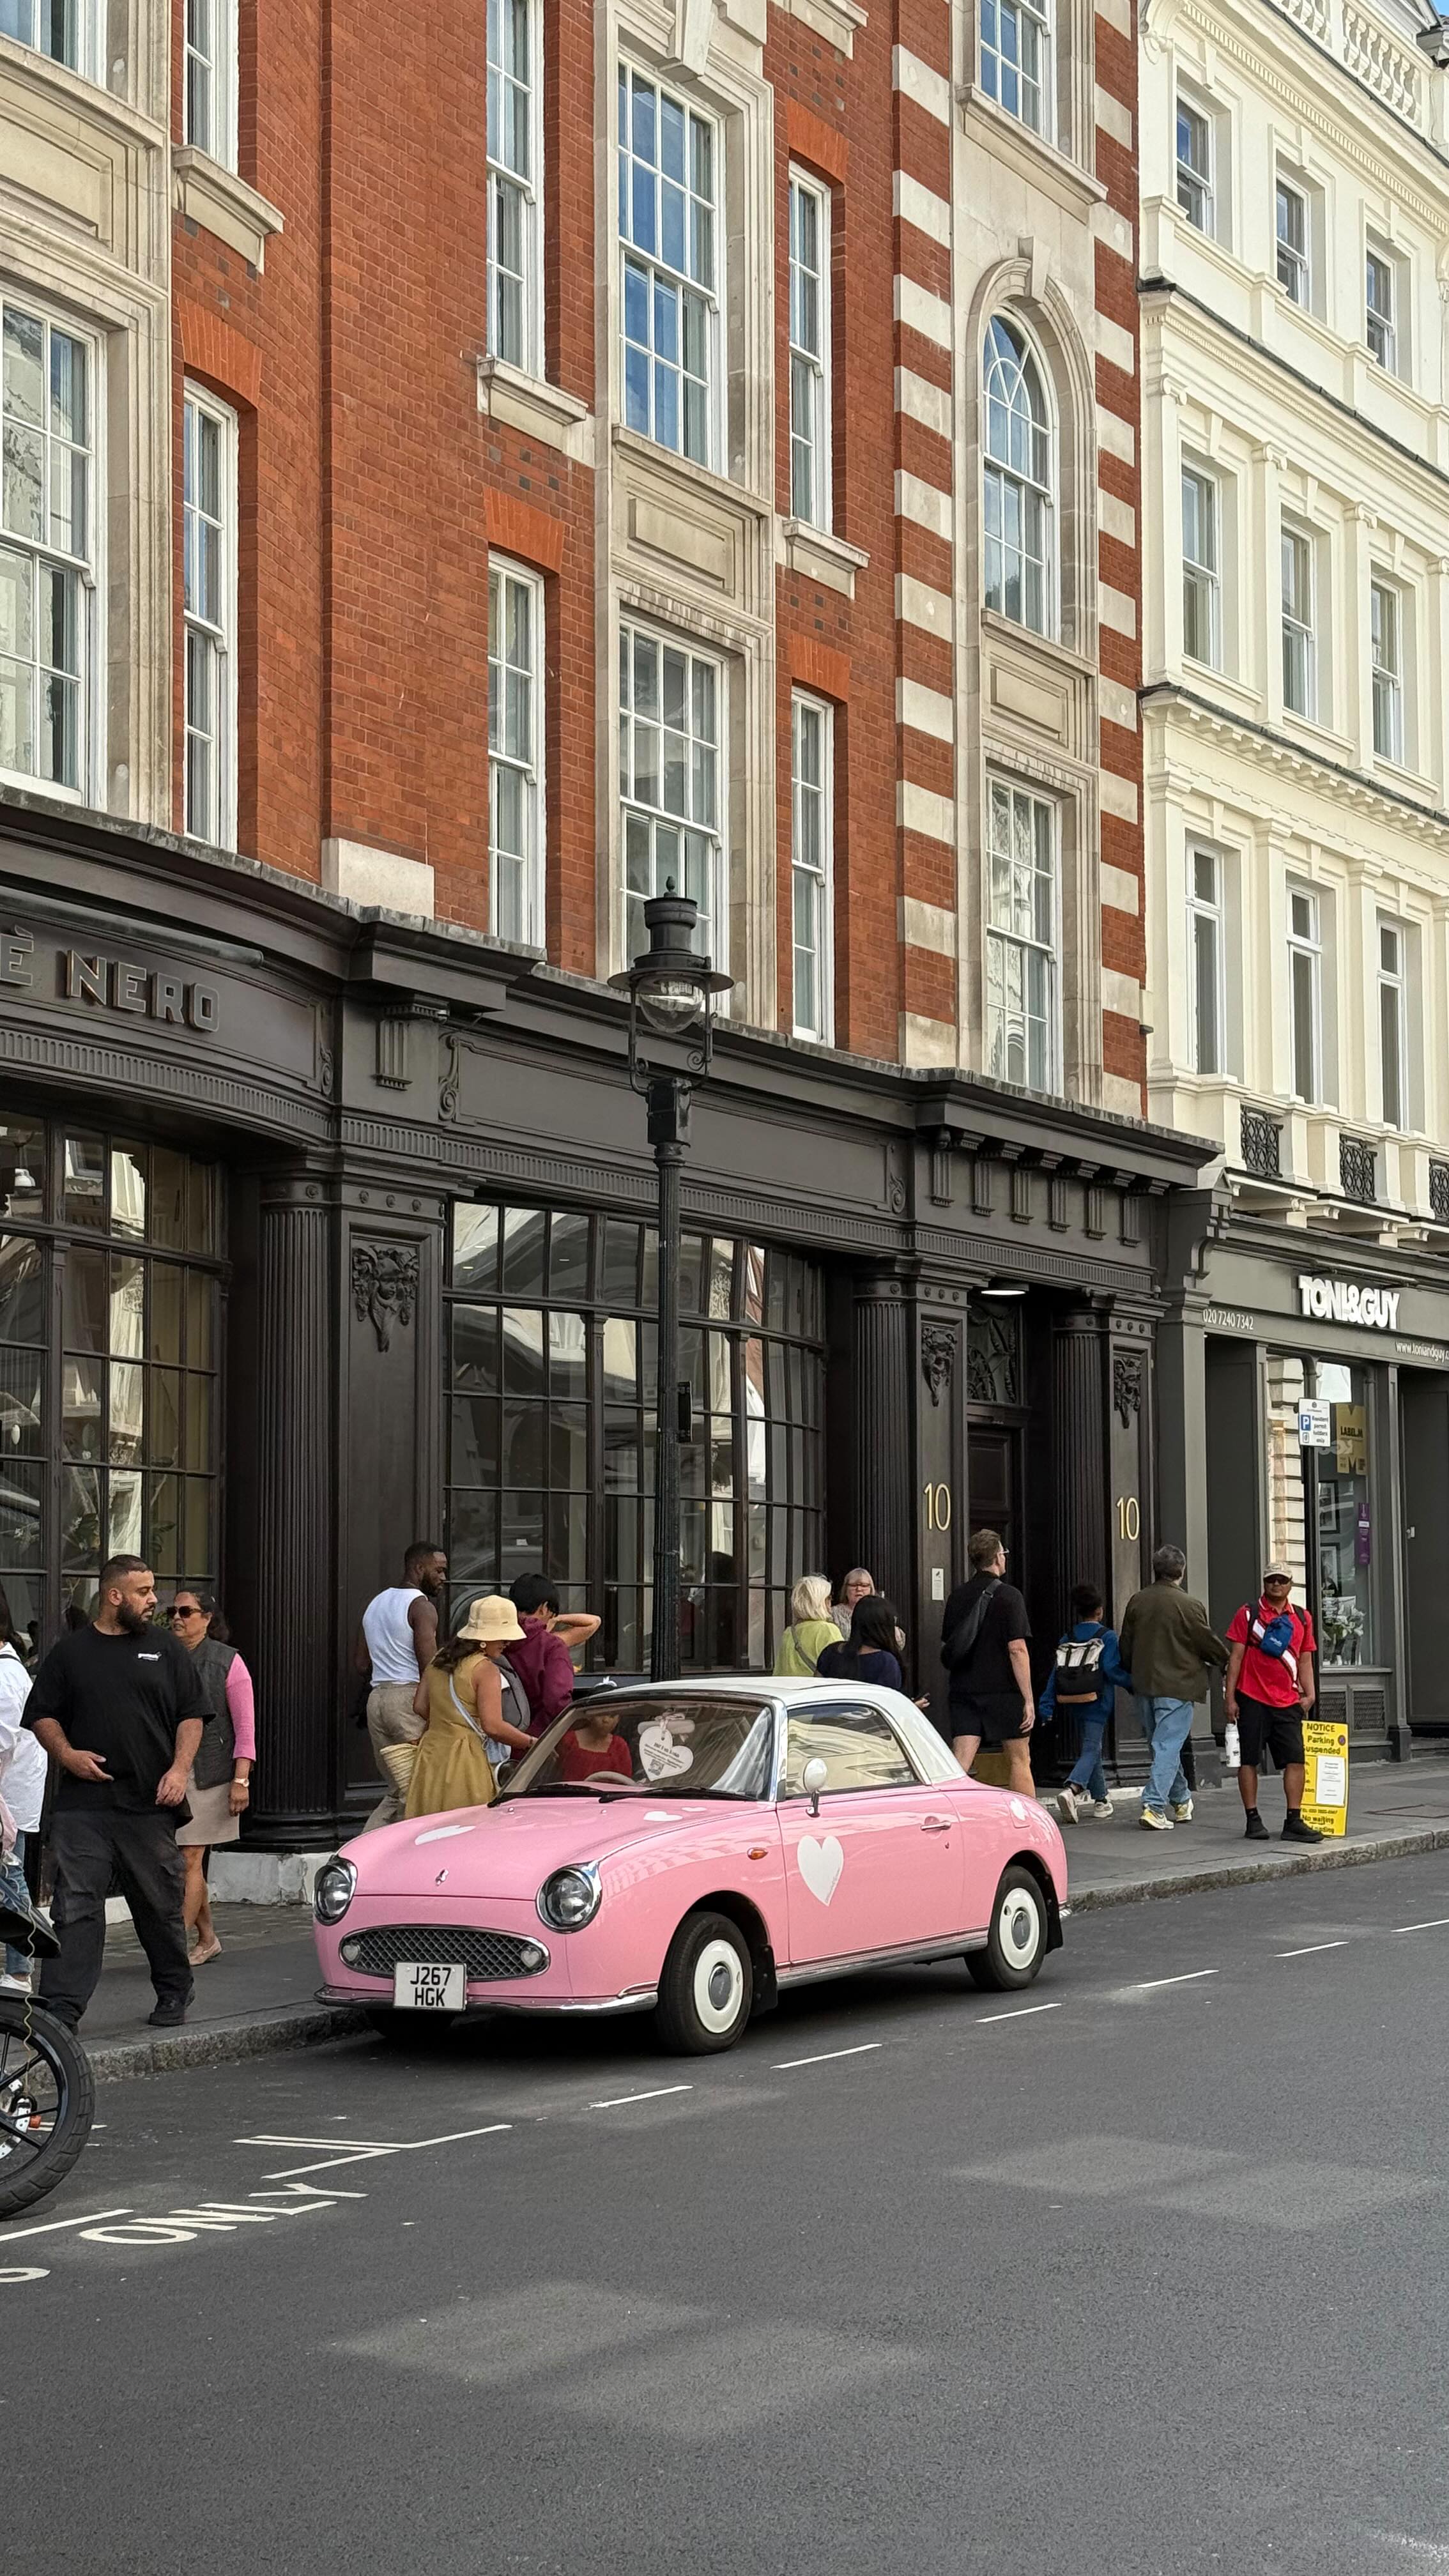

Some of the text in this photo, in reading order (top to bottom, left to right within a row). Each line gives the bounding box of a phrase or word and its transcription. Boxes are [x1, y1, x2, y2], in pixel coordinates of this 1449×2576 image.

[67, 949, 220, 1032] NERO
[1298, 1275, 1400, 1330] TONI&GUY
[1203, 1308, 1254, 1330] 020 7240 7342
[924, 1482, 951, 1531] 10
[1116, 1496, 1140, 1541] 10
[1307, 1723, 1335, 1732] NOTICE
[1303, 1746, 1340, 1754] uspended
[1307, 1735, 1335, 1746] Parking
[410, 1966, 452, 1986] J267
[415, 1987, 446, 2007] HGK
[79, 2183, 369, 2244] ONLY
